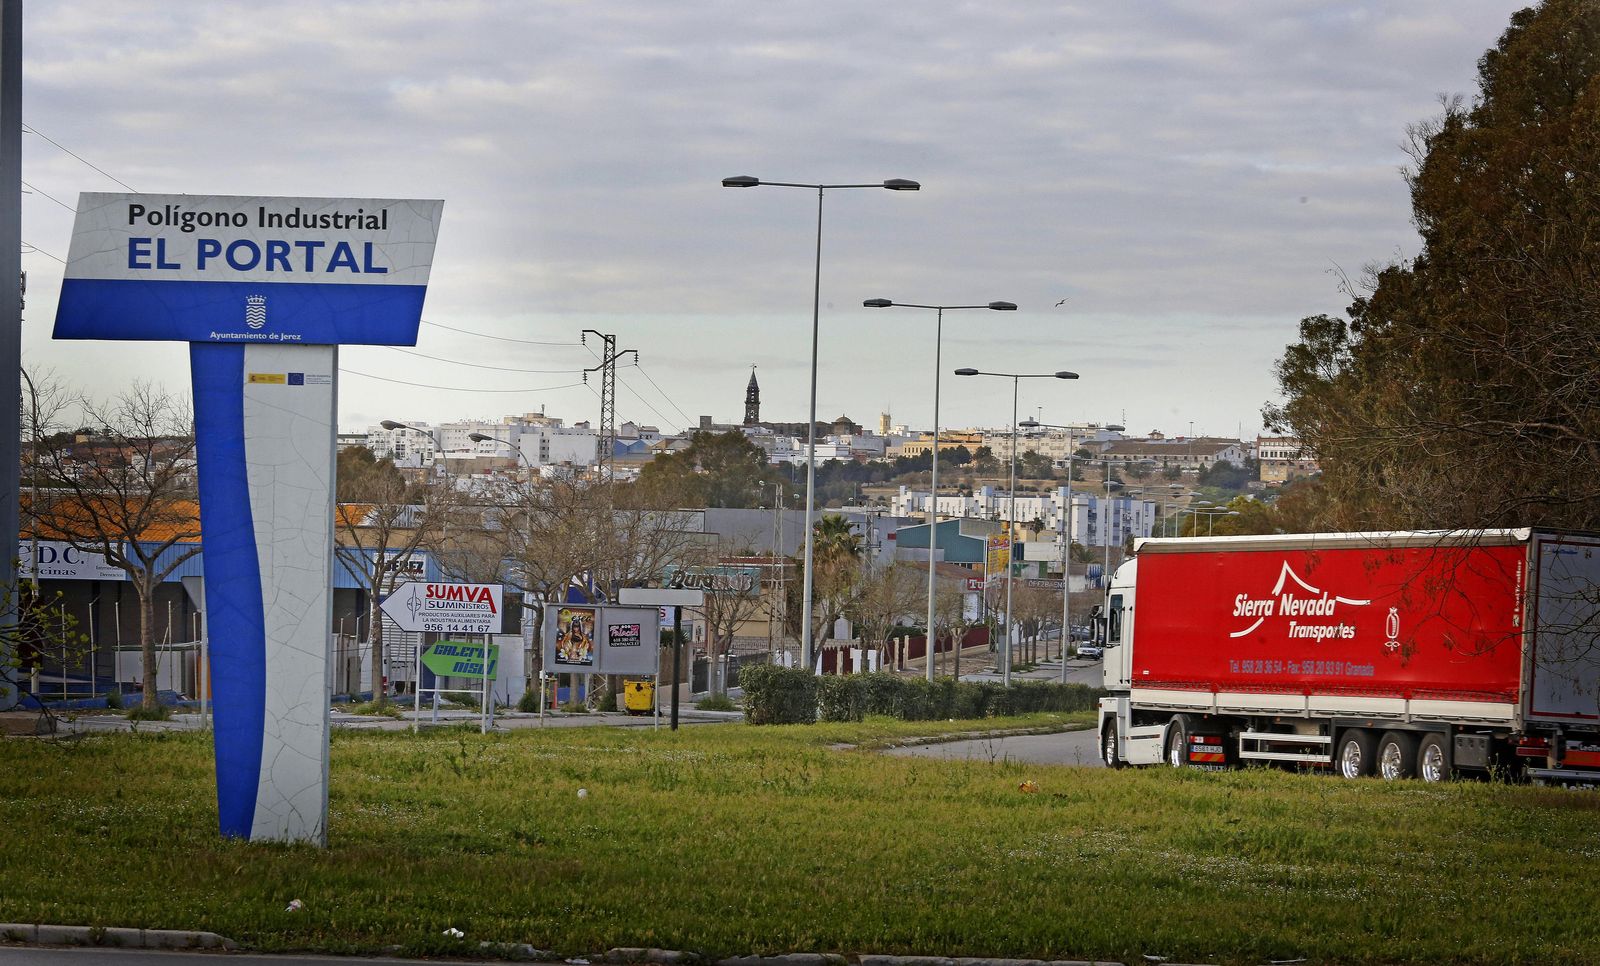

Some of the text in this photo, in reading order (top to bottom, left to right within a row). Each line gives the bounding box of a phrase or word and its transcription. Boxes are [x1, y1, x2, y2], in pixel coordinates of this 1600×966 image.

[128, 204, 387, 233] Polígono Industrial
[128, 237, 388, 273] EL PORTAL
[210, 331, 301, 341] Ayuntamiento de Jerez
[426, 584, 497, 614] SUMVA
[428, 600, 489, 609] SUMINISTROS
[1233, 591, 1336, 617] Sierra Nevada
[462, 624, 474, 632] 41
[1288, 620, 1355, 643] Transportes
[1346, 662, 1375, 677] Granada
